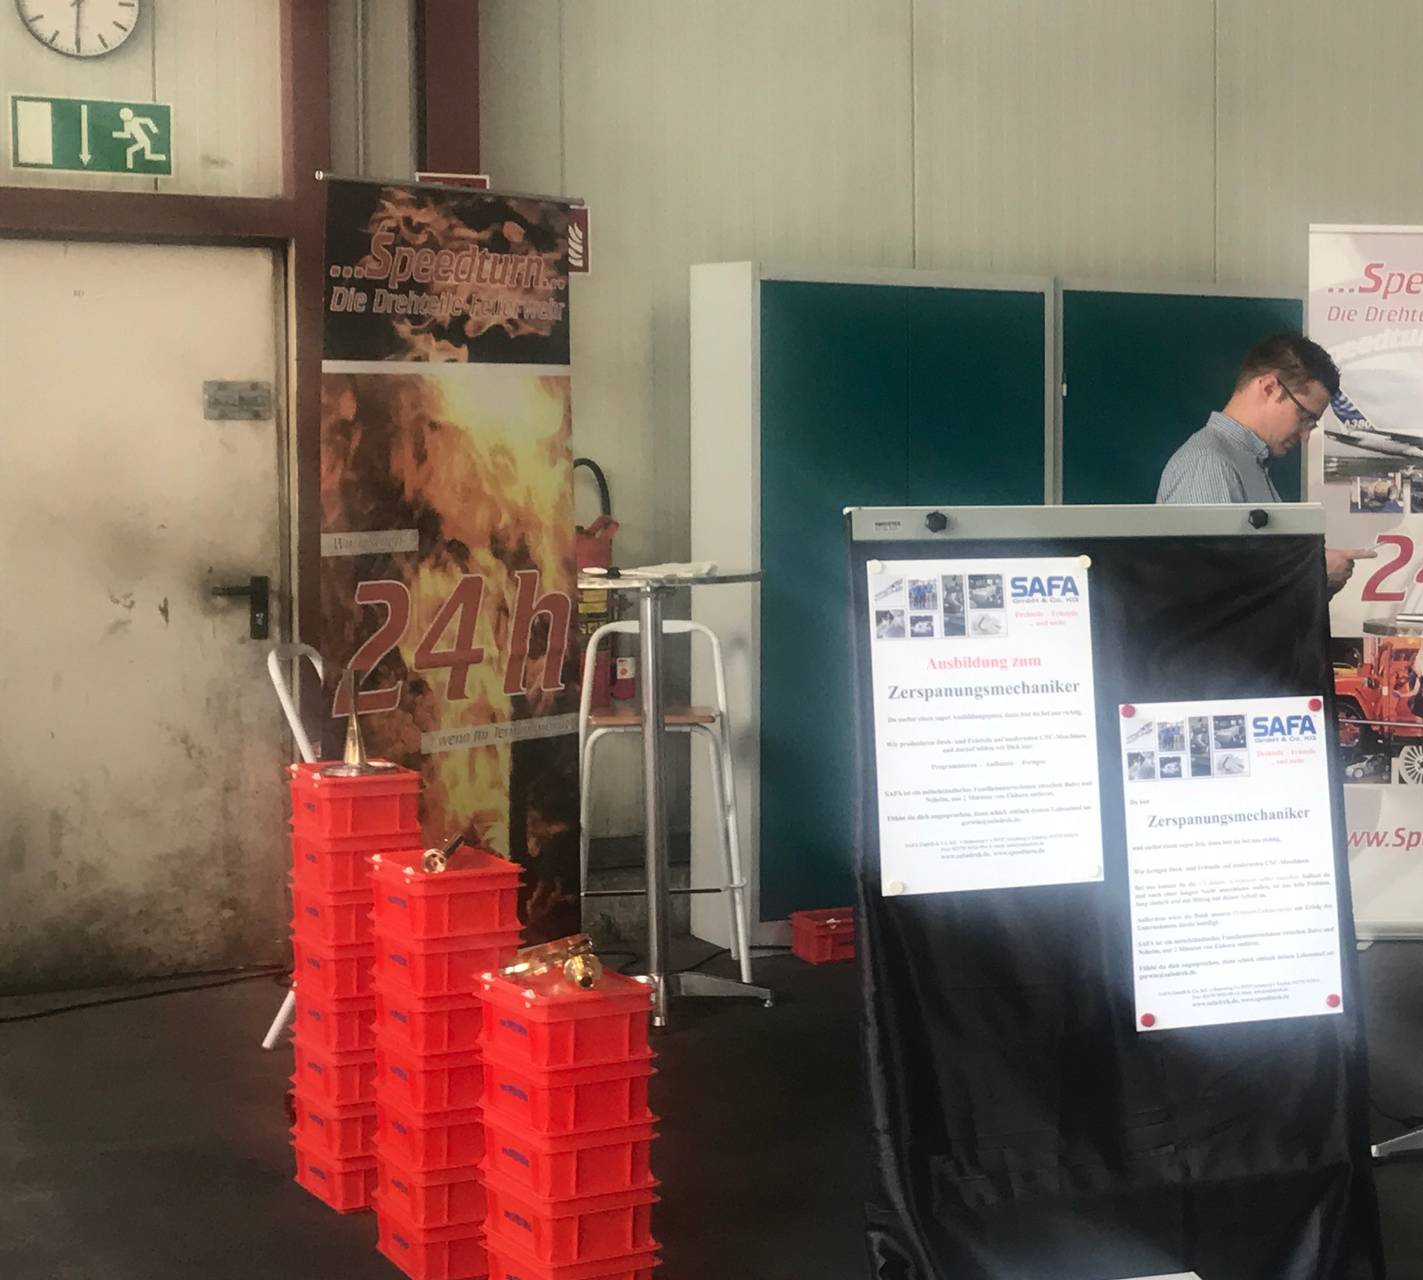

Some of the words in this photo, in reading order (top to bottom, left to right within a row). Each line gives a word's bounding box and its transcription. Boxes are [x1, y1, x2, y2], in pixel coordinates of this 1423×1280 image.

[329, 286, 367, 312] Die
[1327, 305, 1359, 323] Die
[1010, 575, 1080, 598] SAFA
[926, 656, 1008, 671] Ausbildung
[1012, 657, 1042, 667] zum
[887, 680, 1081, 702] Zerspanungsmechaniker
[1252, 715, 1317, 738] SAFA
[1147, 807, 1311, 829] Zerspanungsmechaniker
